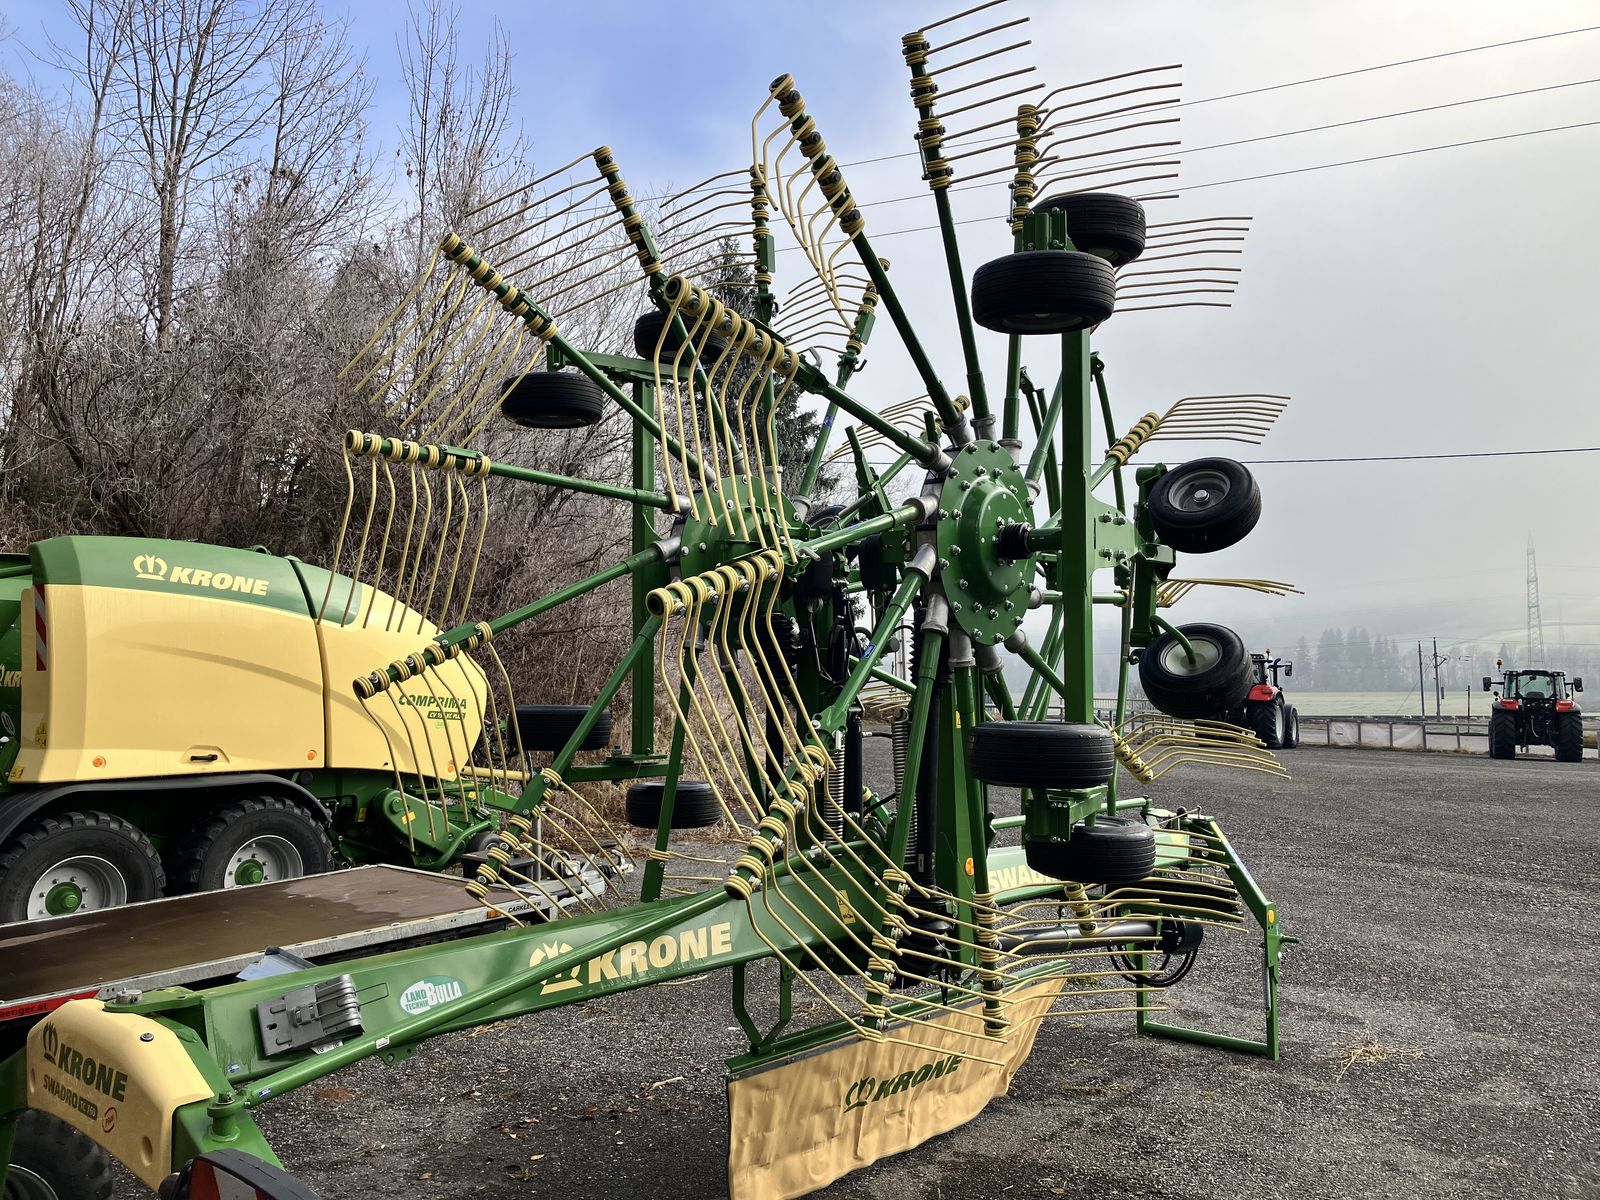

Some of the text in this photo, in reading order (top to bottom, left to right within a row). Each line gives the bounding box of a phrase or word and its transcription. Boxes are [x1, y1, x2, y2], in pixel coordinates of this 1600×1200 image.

[169, 566, 270, 596] KRONE
[398, 694, 467, 709] COMPRIMA
[588, 922, 732, 984] KRONE
[405, 989, 427, 1002] LAND
[405, 1000, 430, 1011] TECHNIK
[428, 981, 463, 1006] BULLA
[58, 1043, 128, 1102] KRONE
[872, 1051, 966, 1102] KRONE
[43, 1074, 78, 1109] SWADRO
